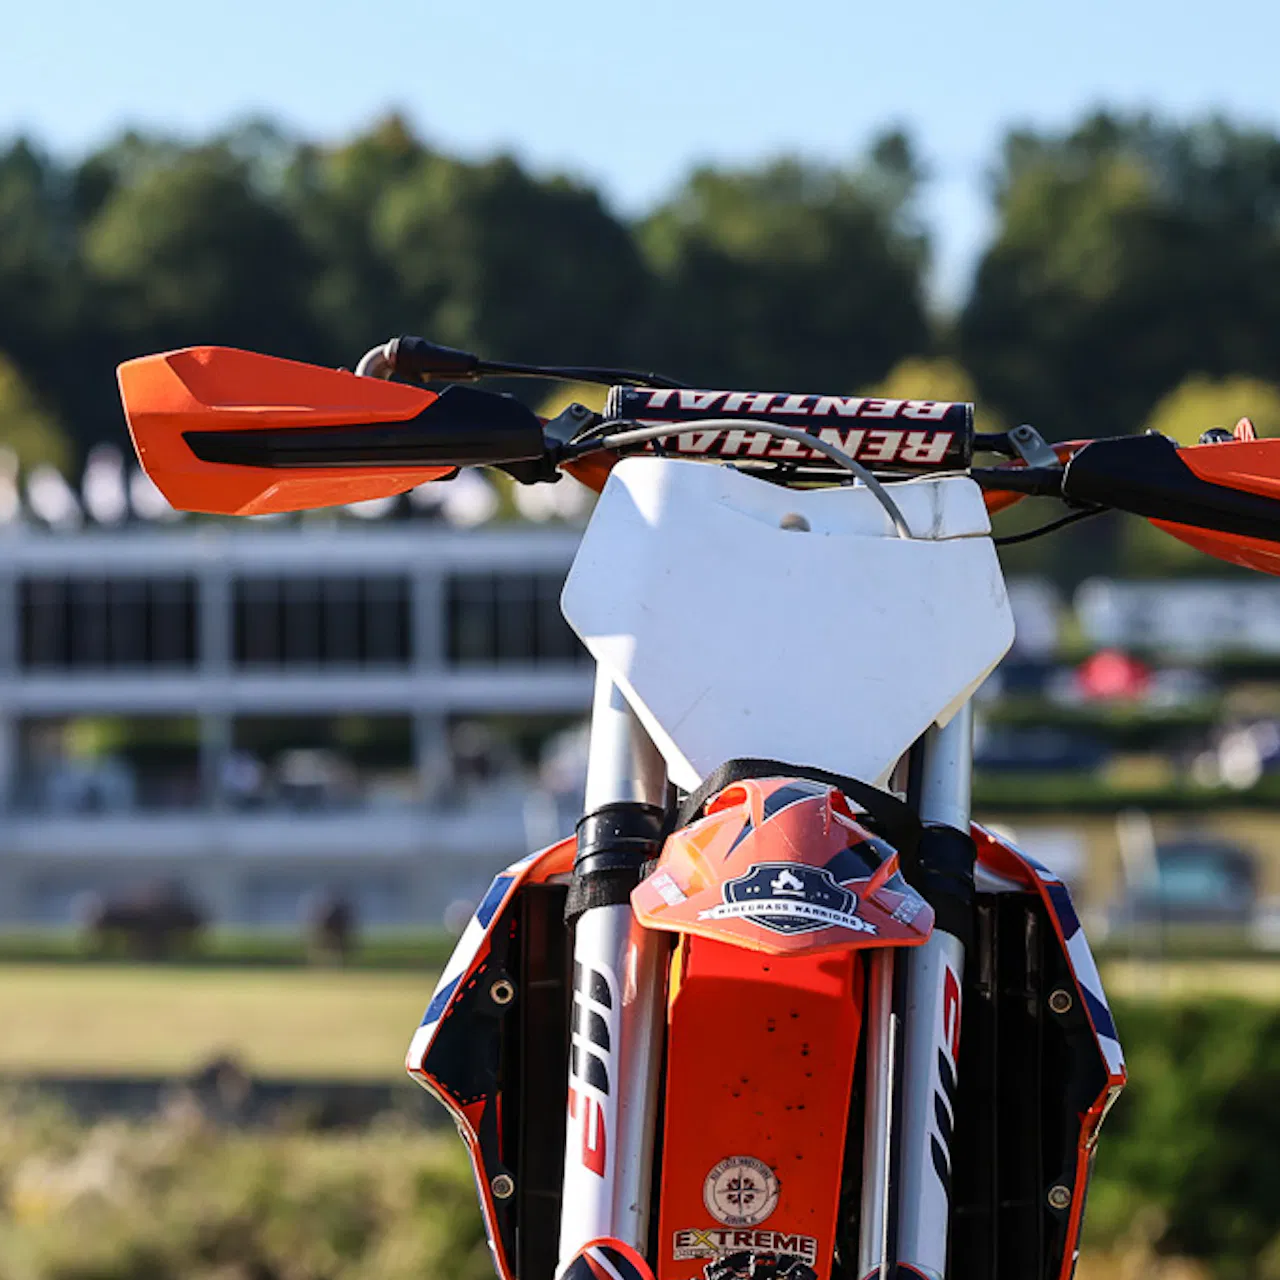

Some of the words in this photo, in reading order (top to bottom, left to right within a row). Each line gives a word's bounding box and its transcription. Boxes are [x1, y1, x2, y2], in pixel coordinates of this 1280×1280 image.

[634, 387, 953, 420] RENTHAL
[794, 907, 857, 927] WARRIORS
[676, 1230, 815, 1256] EXTREME
